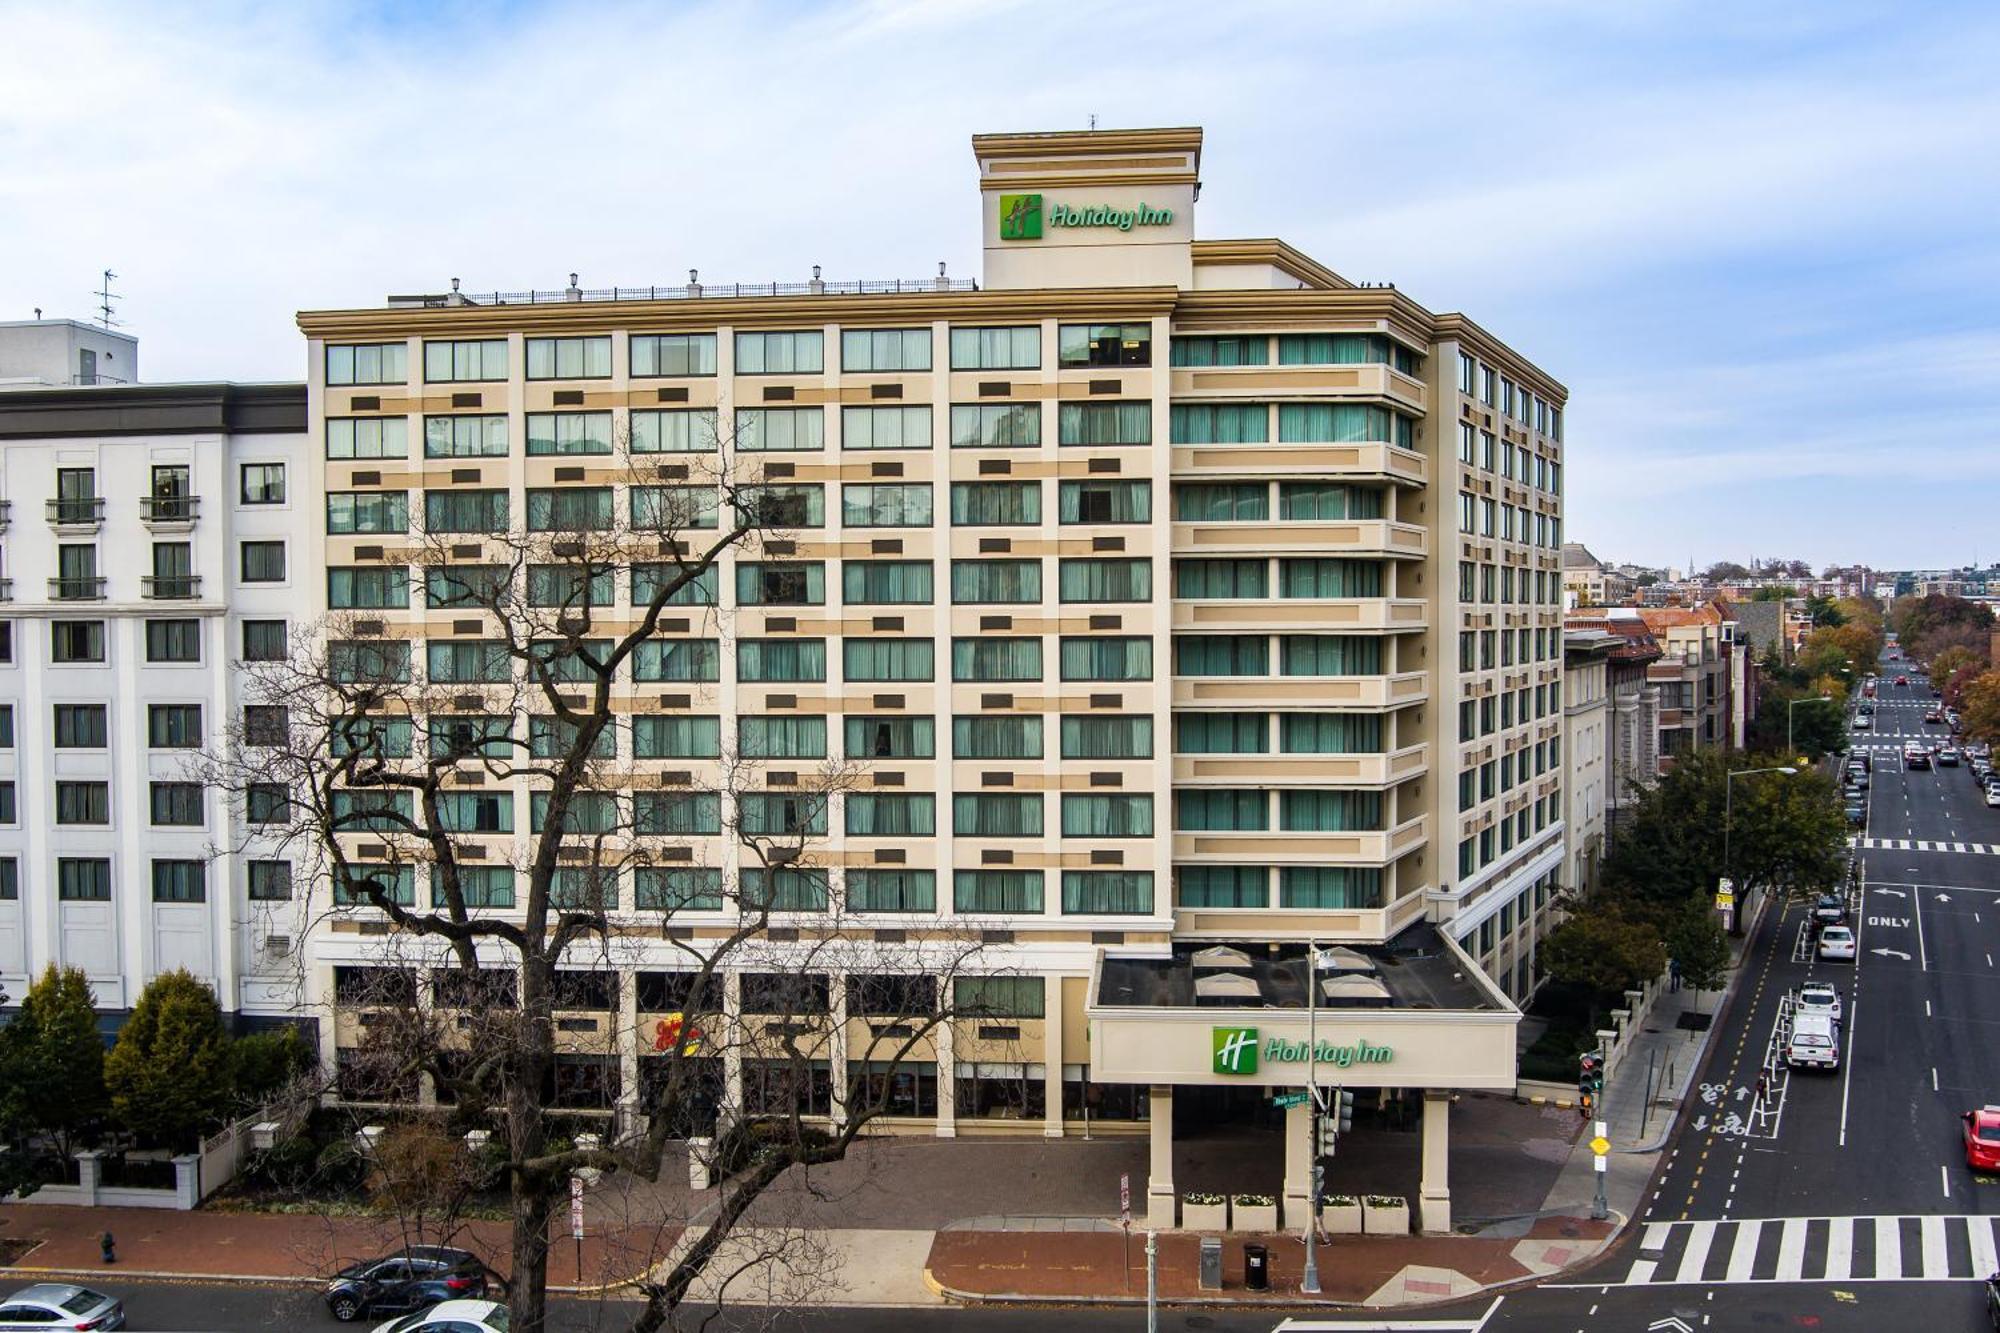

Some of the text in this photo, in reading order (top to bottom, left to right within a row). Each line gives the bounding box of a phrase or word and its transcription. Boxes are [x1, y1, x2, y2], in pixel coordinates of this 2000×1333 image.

[1050, 202, 1135, 232] Holiday
[1137, 201, 1174, 226] Inn
[1868, 916, 1911, 928] ONLY
[1264, 1038, 1353, 1068] Holiday
[1356, 1038, 1393, 1063] Inn
